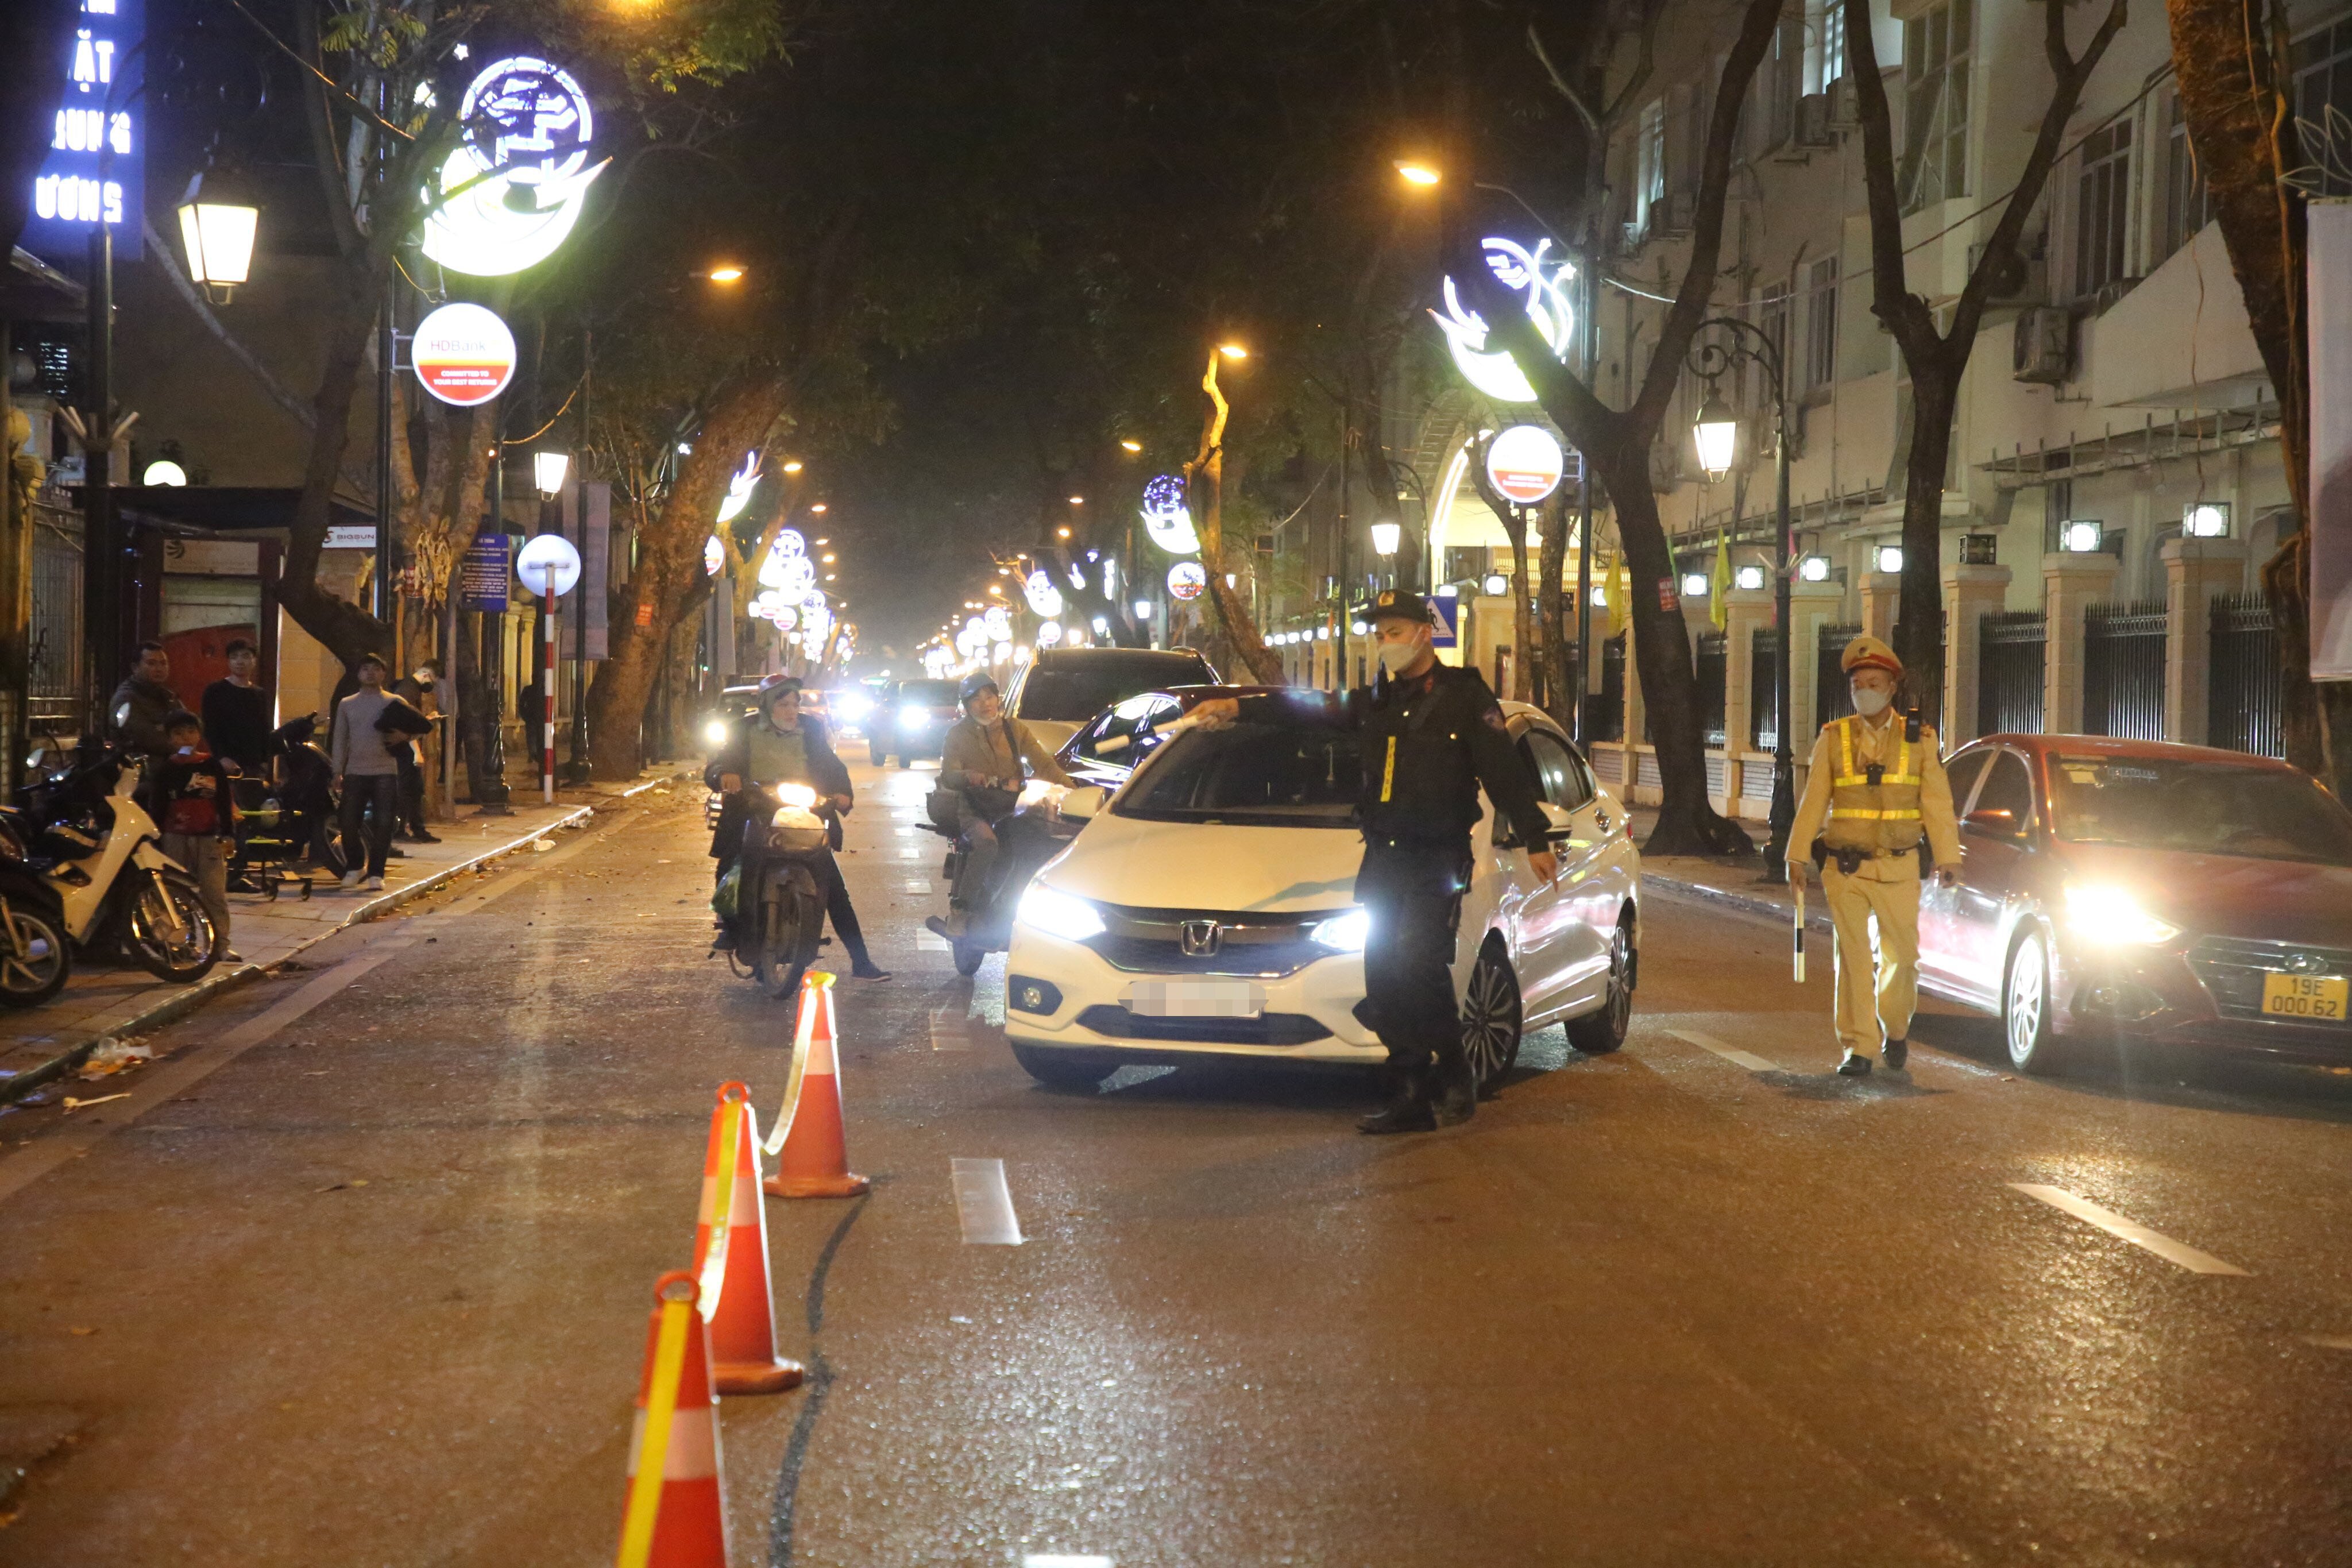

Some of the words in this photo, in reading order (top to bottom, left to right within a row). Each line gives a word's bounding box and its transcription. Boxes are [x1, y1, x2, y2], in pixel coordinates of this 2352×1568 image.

[430, 339, 486, 352] HDBank
[2291, 977, 2324, 997] 19E
[2272, 995, 2338, 1018] 000.62
